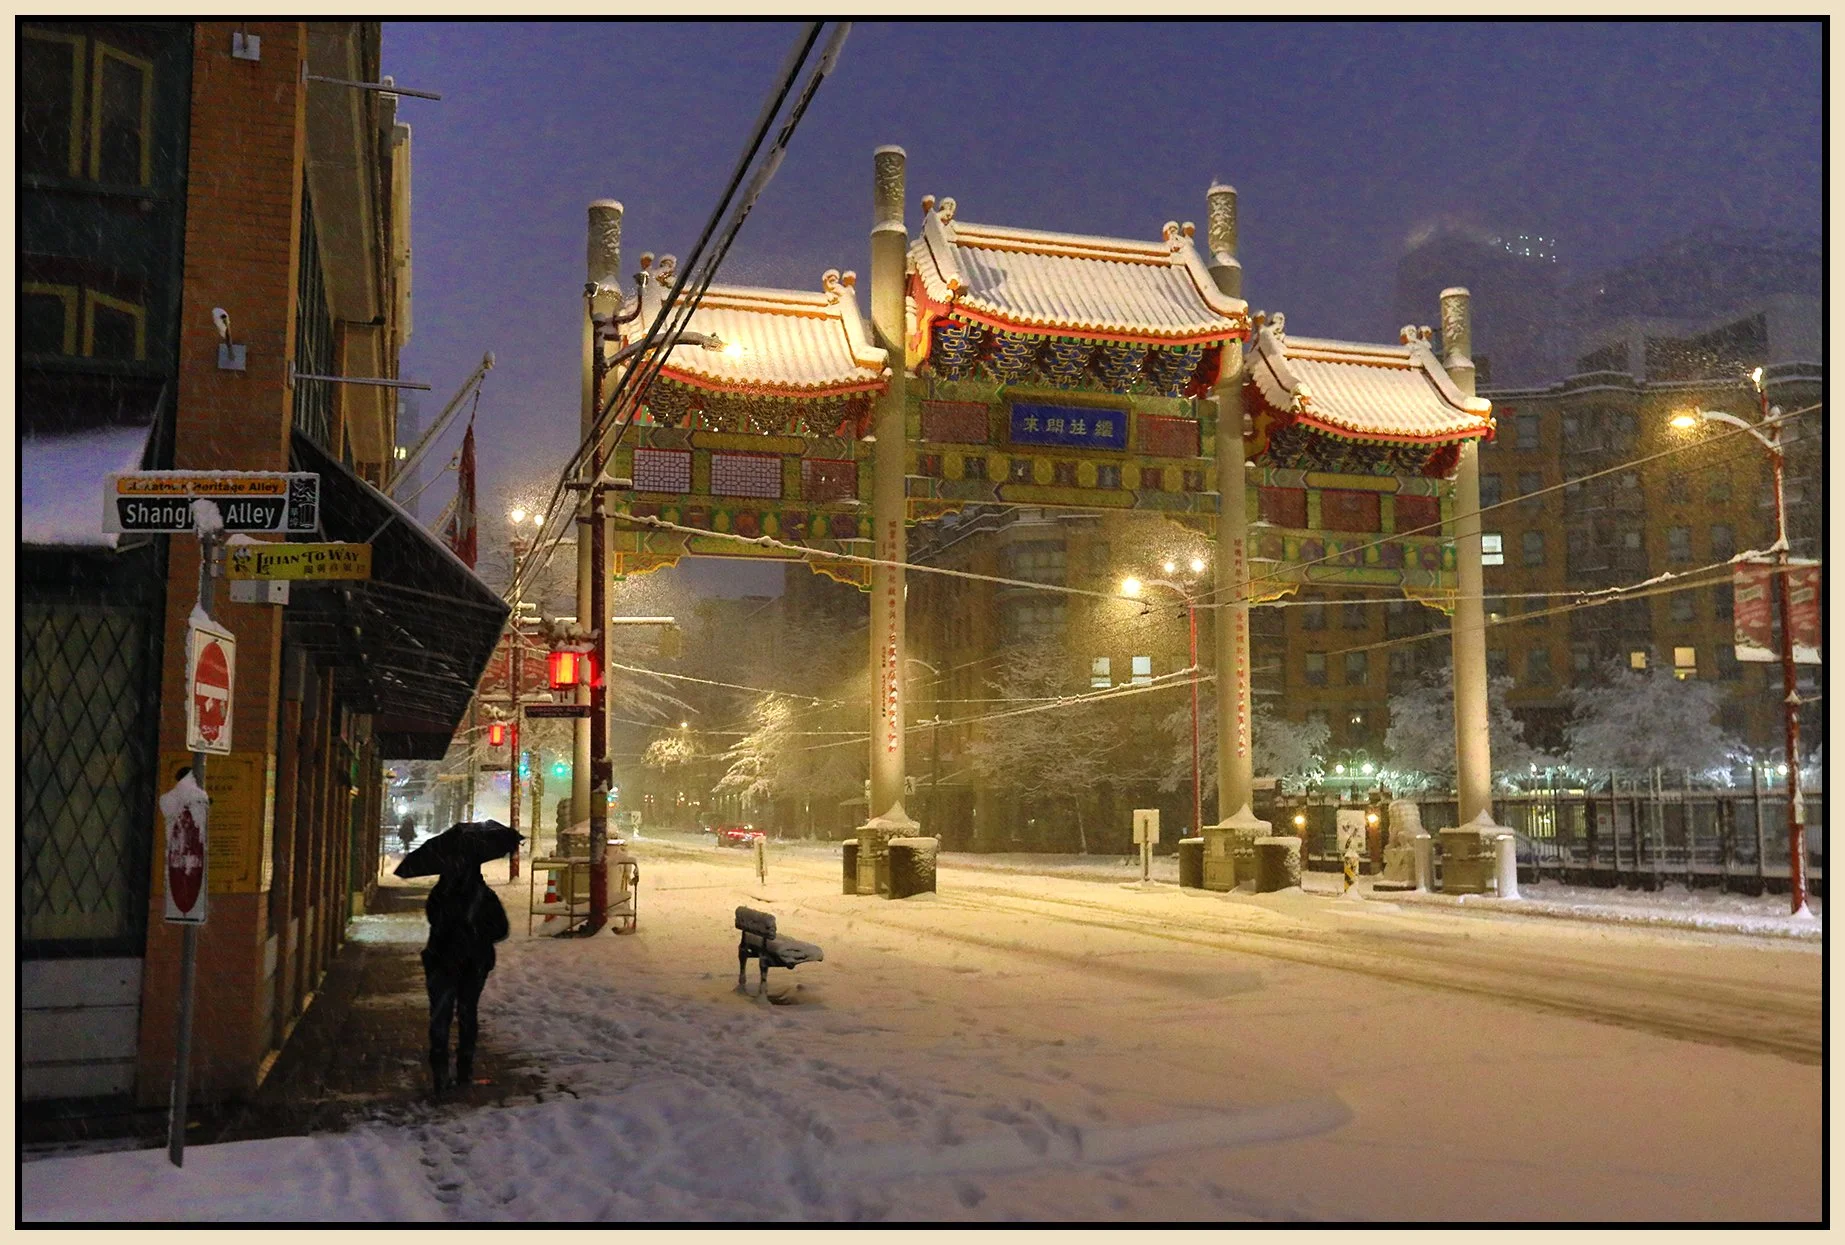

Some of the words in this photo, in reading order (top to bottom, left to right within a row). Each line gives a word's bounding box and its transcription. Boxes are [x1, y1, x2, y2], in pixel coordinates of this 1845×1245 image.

[249, 482, 279, 492] Alley
[126, 503, 194, 529] Shang
[226, 503, 275, 529] Alley
